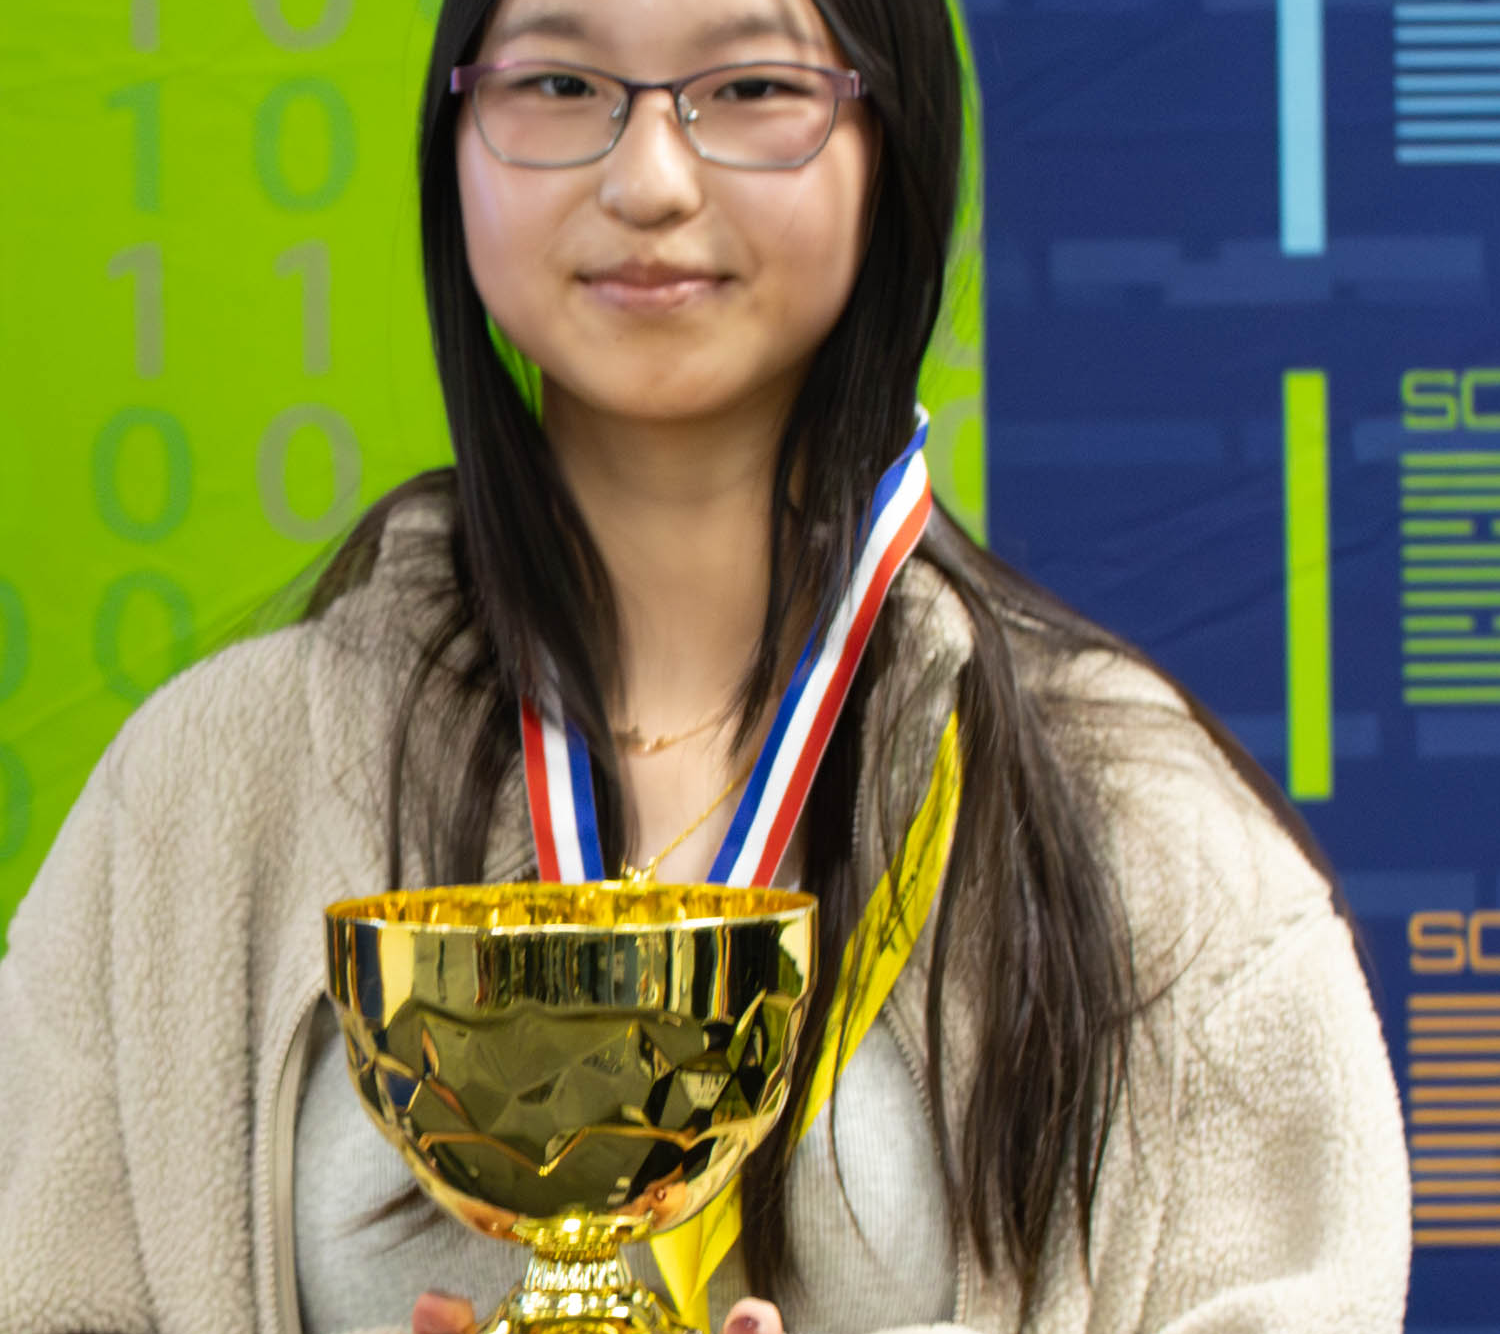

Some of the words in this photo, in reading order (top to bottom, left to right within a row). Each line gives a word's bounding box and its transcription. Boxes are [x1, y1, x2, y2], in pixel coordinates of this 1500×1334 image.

[105, 79, 162, 214] 1
[253, 75, 358, 212] 0
[107, 241, 165, 379] 1
[273, 238, 331, 377] 1
[90, 404, 194, 545] 0
[256, 402, 363, 543] 0
